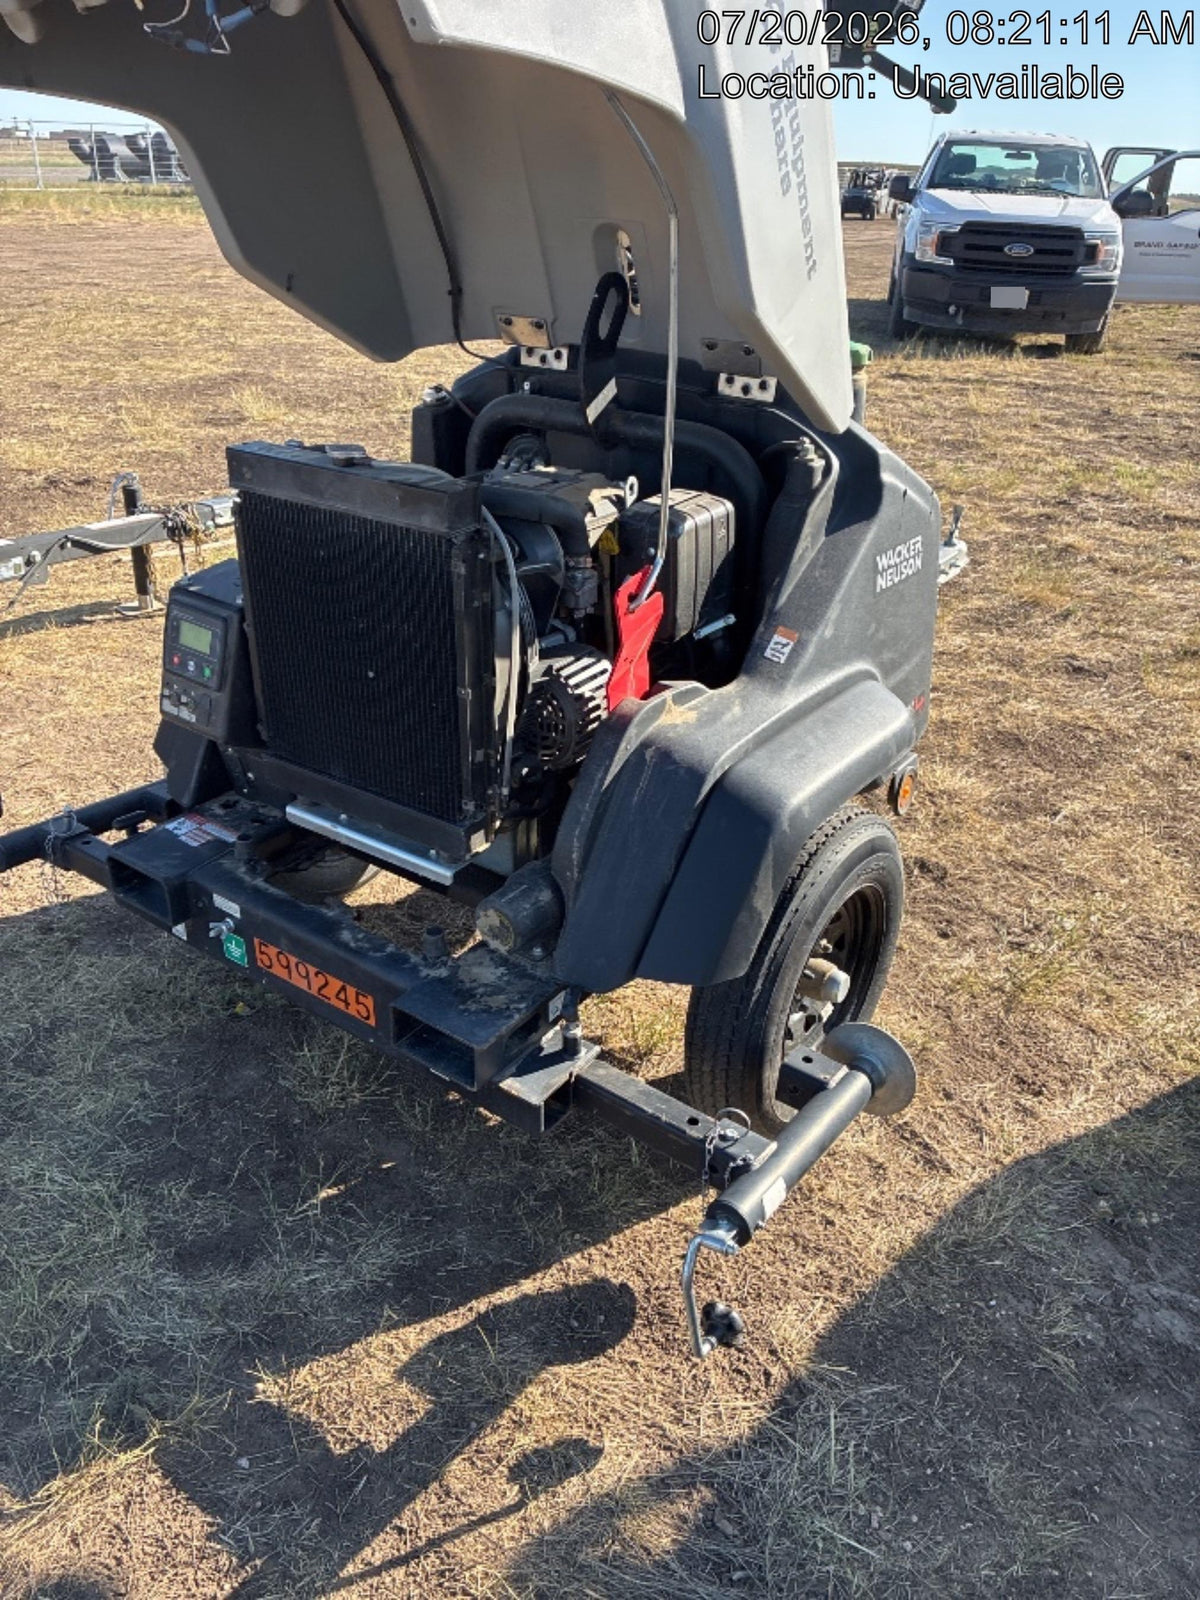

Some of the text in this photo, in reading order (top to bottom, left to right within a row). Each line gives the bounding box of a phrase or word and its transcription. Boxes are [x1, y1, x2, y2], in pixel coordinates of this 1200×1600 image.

[876, 535, 922, 572] WACKER
[876, 553, 922, 592] NEUSON
[259, 941, 371, 1021] 599245
